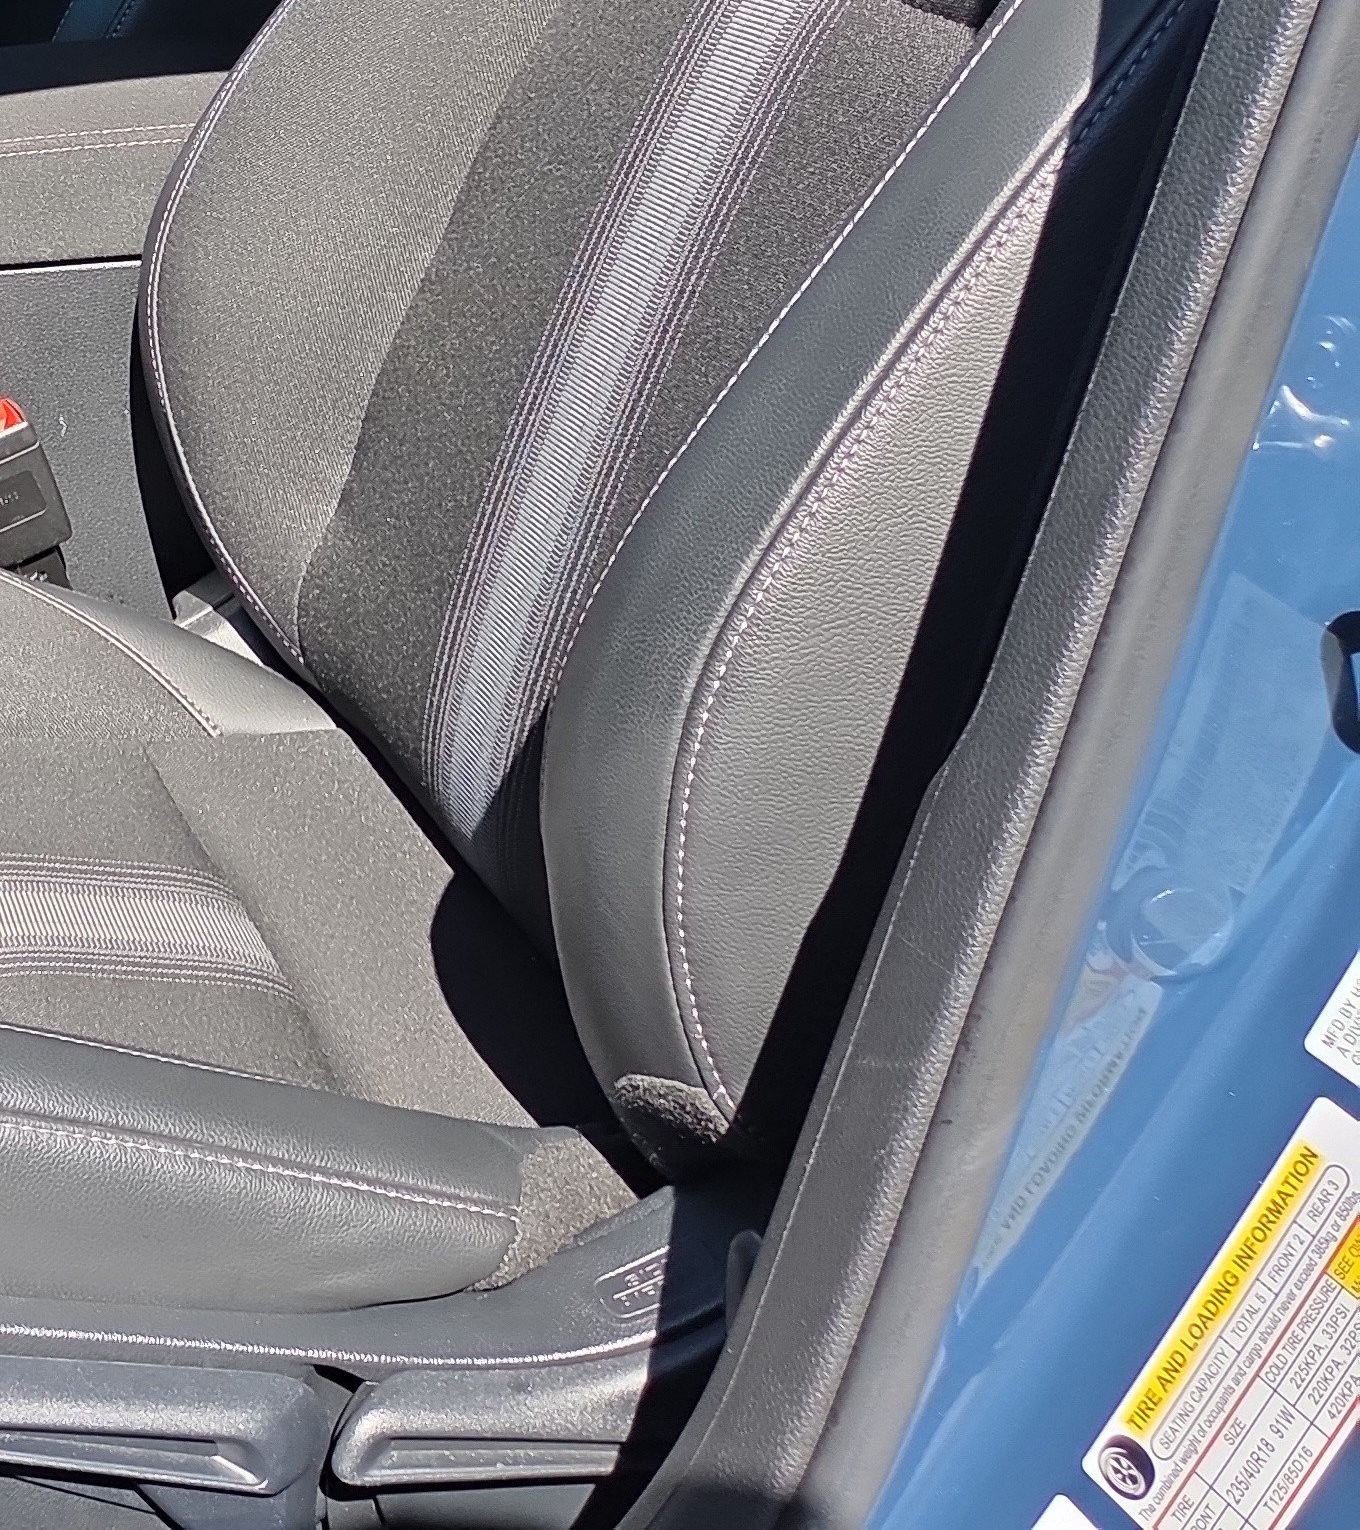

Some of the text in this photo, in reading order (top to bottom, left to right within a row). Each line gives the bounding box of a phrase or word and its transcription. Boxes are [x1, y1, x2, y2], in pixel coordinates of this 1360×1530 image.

[1321, 1018, 1346, 1049] MFD
[1306, 1179, 1340, 1223] REAR 3
[1126, 1145, 1319, 1431] TIRE AND LOADING INFORMATION
[1267, 1233, 1306, 1284] FRONT 2
[1333, 1254, 1355, 1281] SEE
[1229, 1292, 1267, 1339] TOTAL 5
[1264, 1278, 1338, 1384] COLD TIRE PRESSURE
[1138, 1503, 1157, 1522] The
[1152, 1460, 1184, 1506] combined
[1178, 1434, 1202, 1466] weight
[1197, 1422, 1208, 1438] of
[1203, 1384, 1236, 1429] occupants
[1231, 1365, 1247, 1387] and
[1242, 1342, 1263, 1369] cargo
[1258, 1311, 1282, 1345] should
[1276, 1288, 1298, 1317] never
[1293, 1255, 1318, 1292] exceed
[1330, 1219, 1342, 1233] or
[1289, 1302, 1351, 1391] 225KPA, 33PSI
[1307, 1321, 1360, 1406] 220KPA, 32PS
[1159, 1346, 1229, 1451] SEATING CAPACITY
[1223, 1416, 1247, 1446] SIZE
[1225, 1404, 1296, 1506] 235/40R18 91W
[1170, 1494, 1195, 1523] TIRE
[1262, 1445, 1314, 1513] T125/85D16
[1190, 1503, 1216, 1530] ONT
